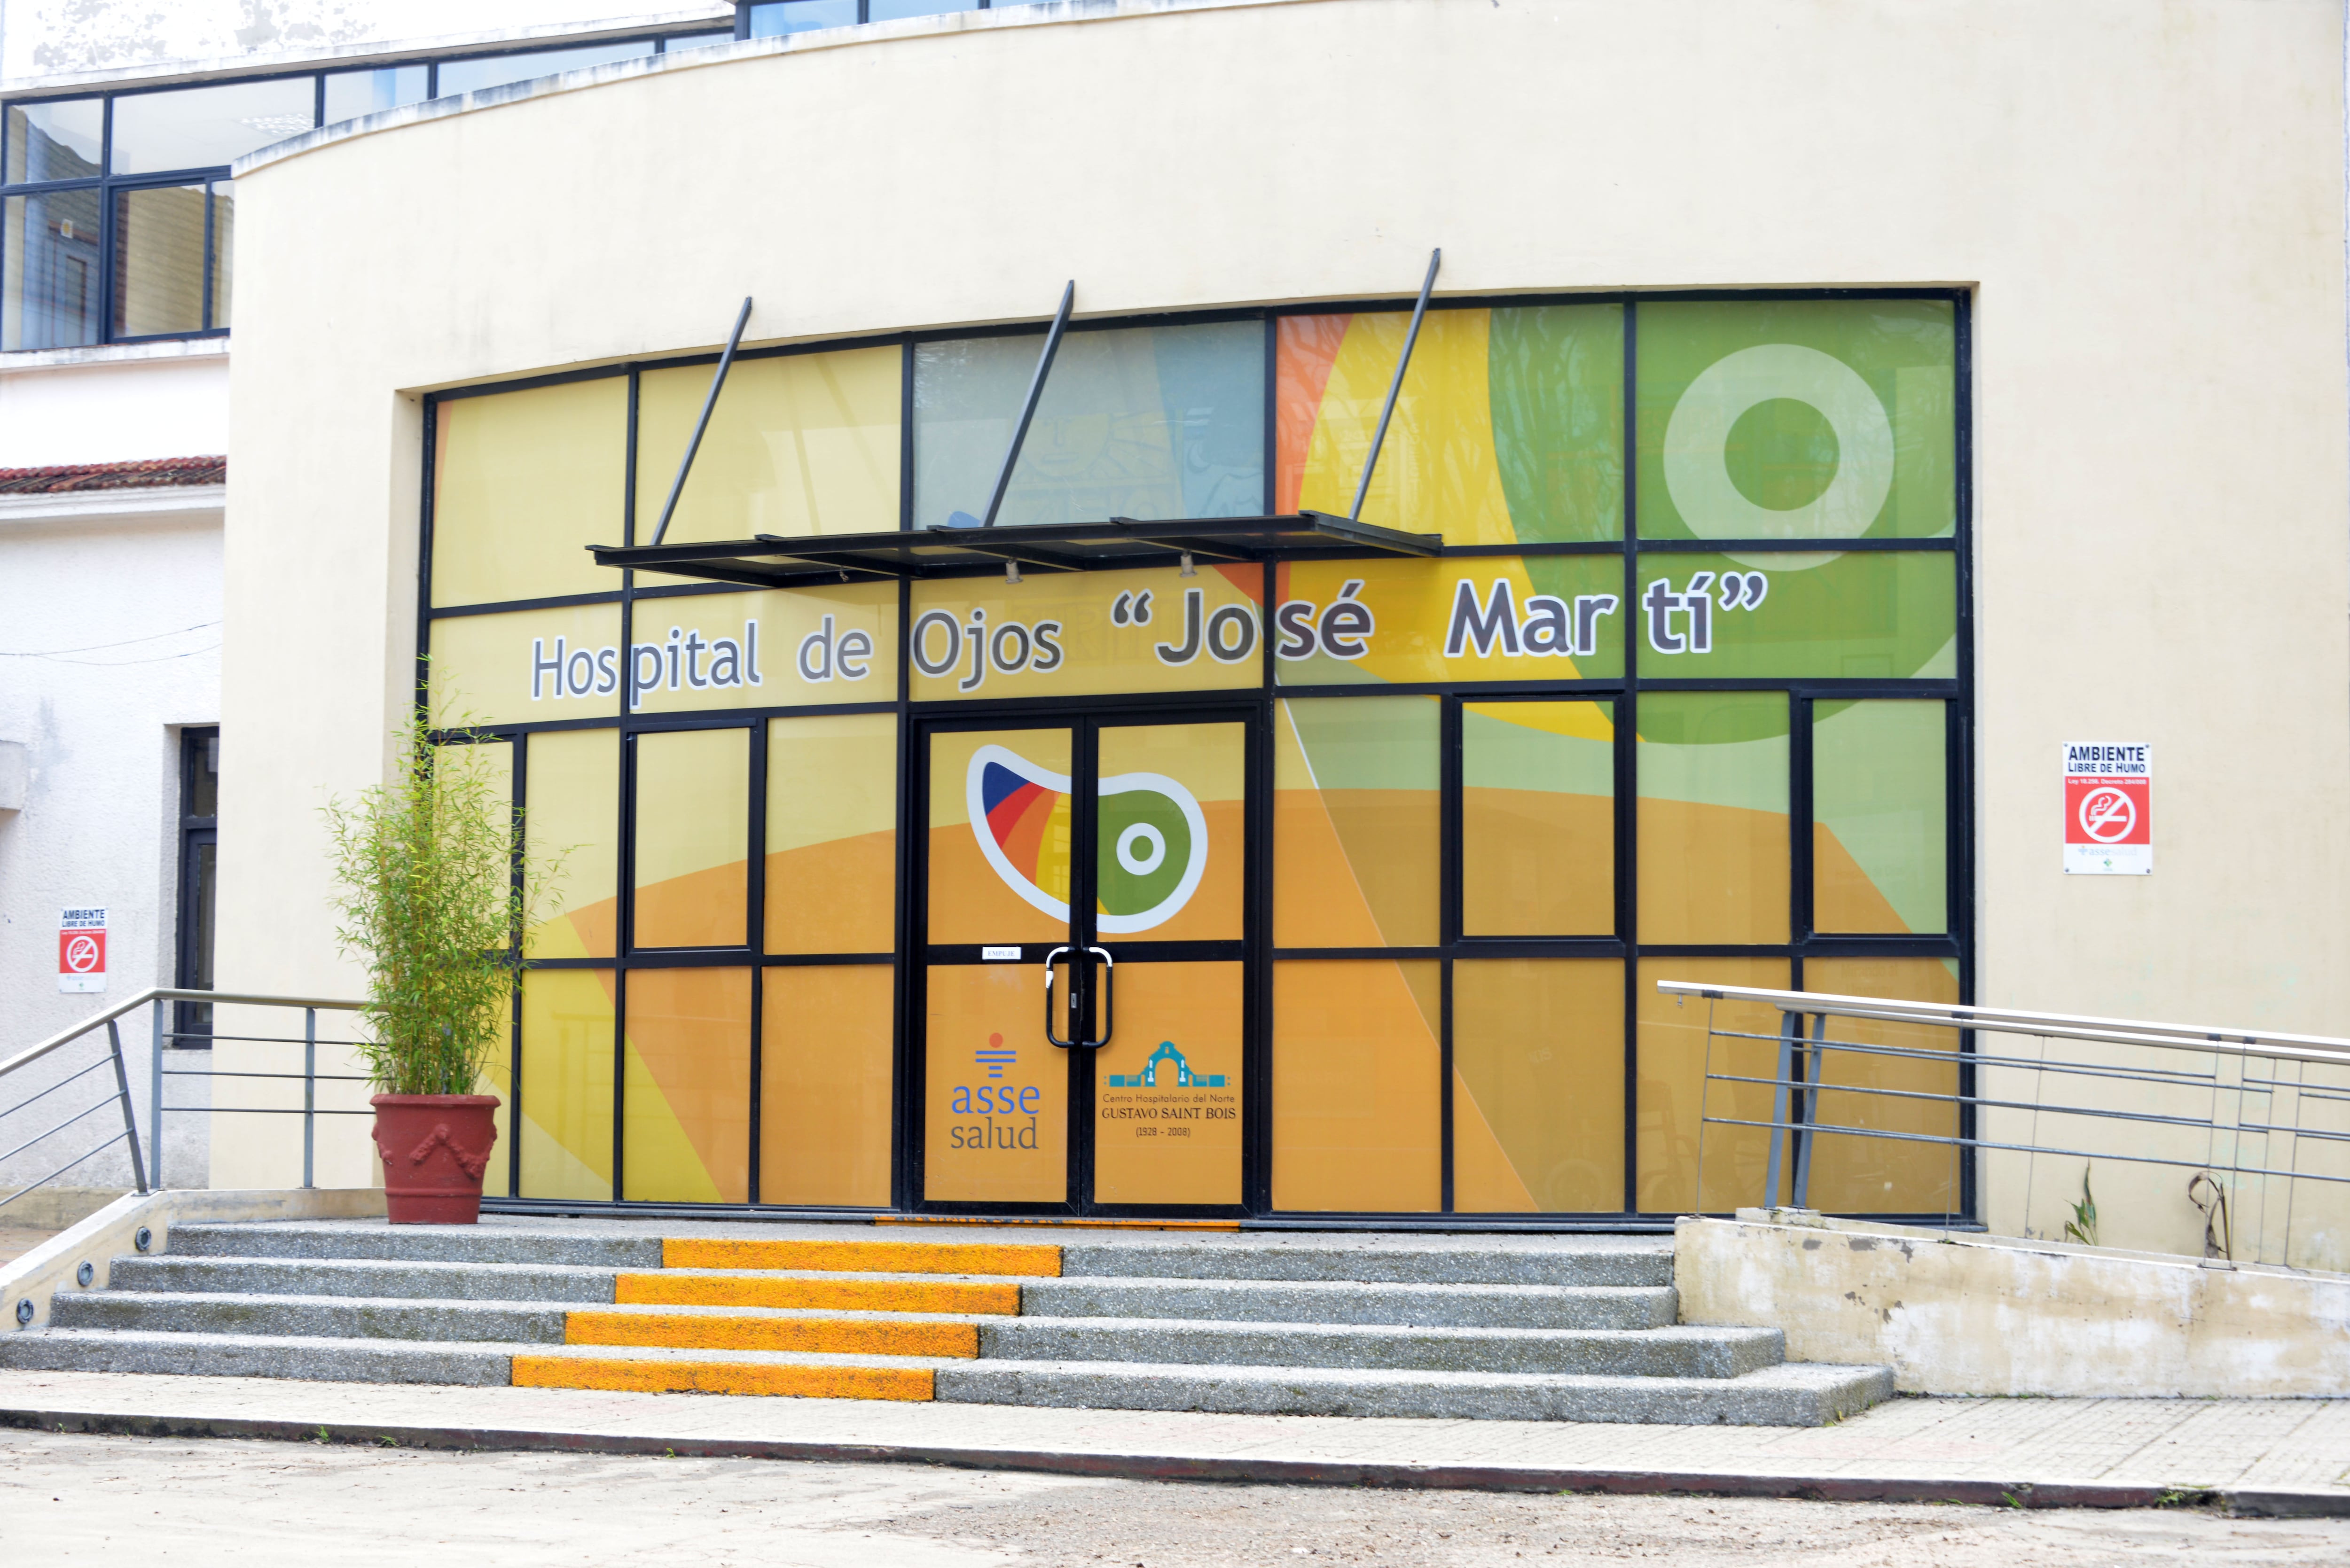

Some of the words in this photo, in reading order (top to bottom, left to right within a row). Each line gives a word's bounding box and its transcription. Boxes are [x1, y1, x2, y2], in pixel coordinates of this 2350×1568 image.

[532, 620, 760, 707] Hospital
[799, 616, 872, 681] de
[912, 609, 1062, 691] Ojos
[2068, 746, 2145, 761] AMBIENTE
[2068, 762, 2096, 772] LIBRE
[2100, 763, 2112, 772] DE
[2116, 763, 2146, 773] HUMO
[63, 909, 105, 920] AMBIENTE
[951, 1085, 1040, 1115] asse
[1103, 1093, 1132, 1102] Centro
[1136, 1093, 1190, 1104] Hospitalario
[1193, 1093, 1206, 1102] del
[1210, 1094, 1235, 1102] Norte
[1102, 1108, 1158, 1119] GUSTAVO
[1161, 1108, 1201, 1119] SAINT
[1206, 1108, 1237, 1119] BOIS
[950, 1116, 1040, 1150] salud
[1136, 1127, 1158, 1138] (1928
[1167, 1127, 1191, 1138] 2008)
